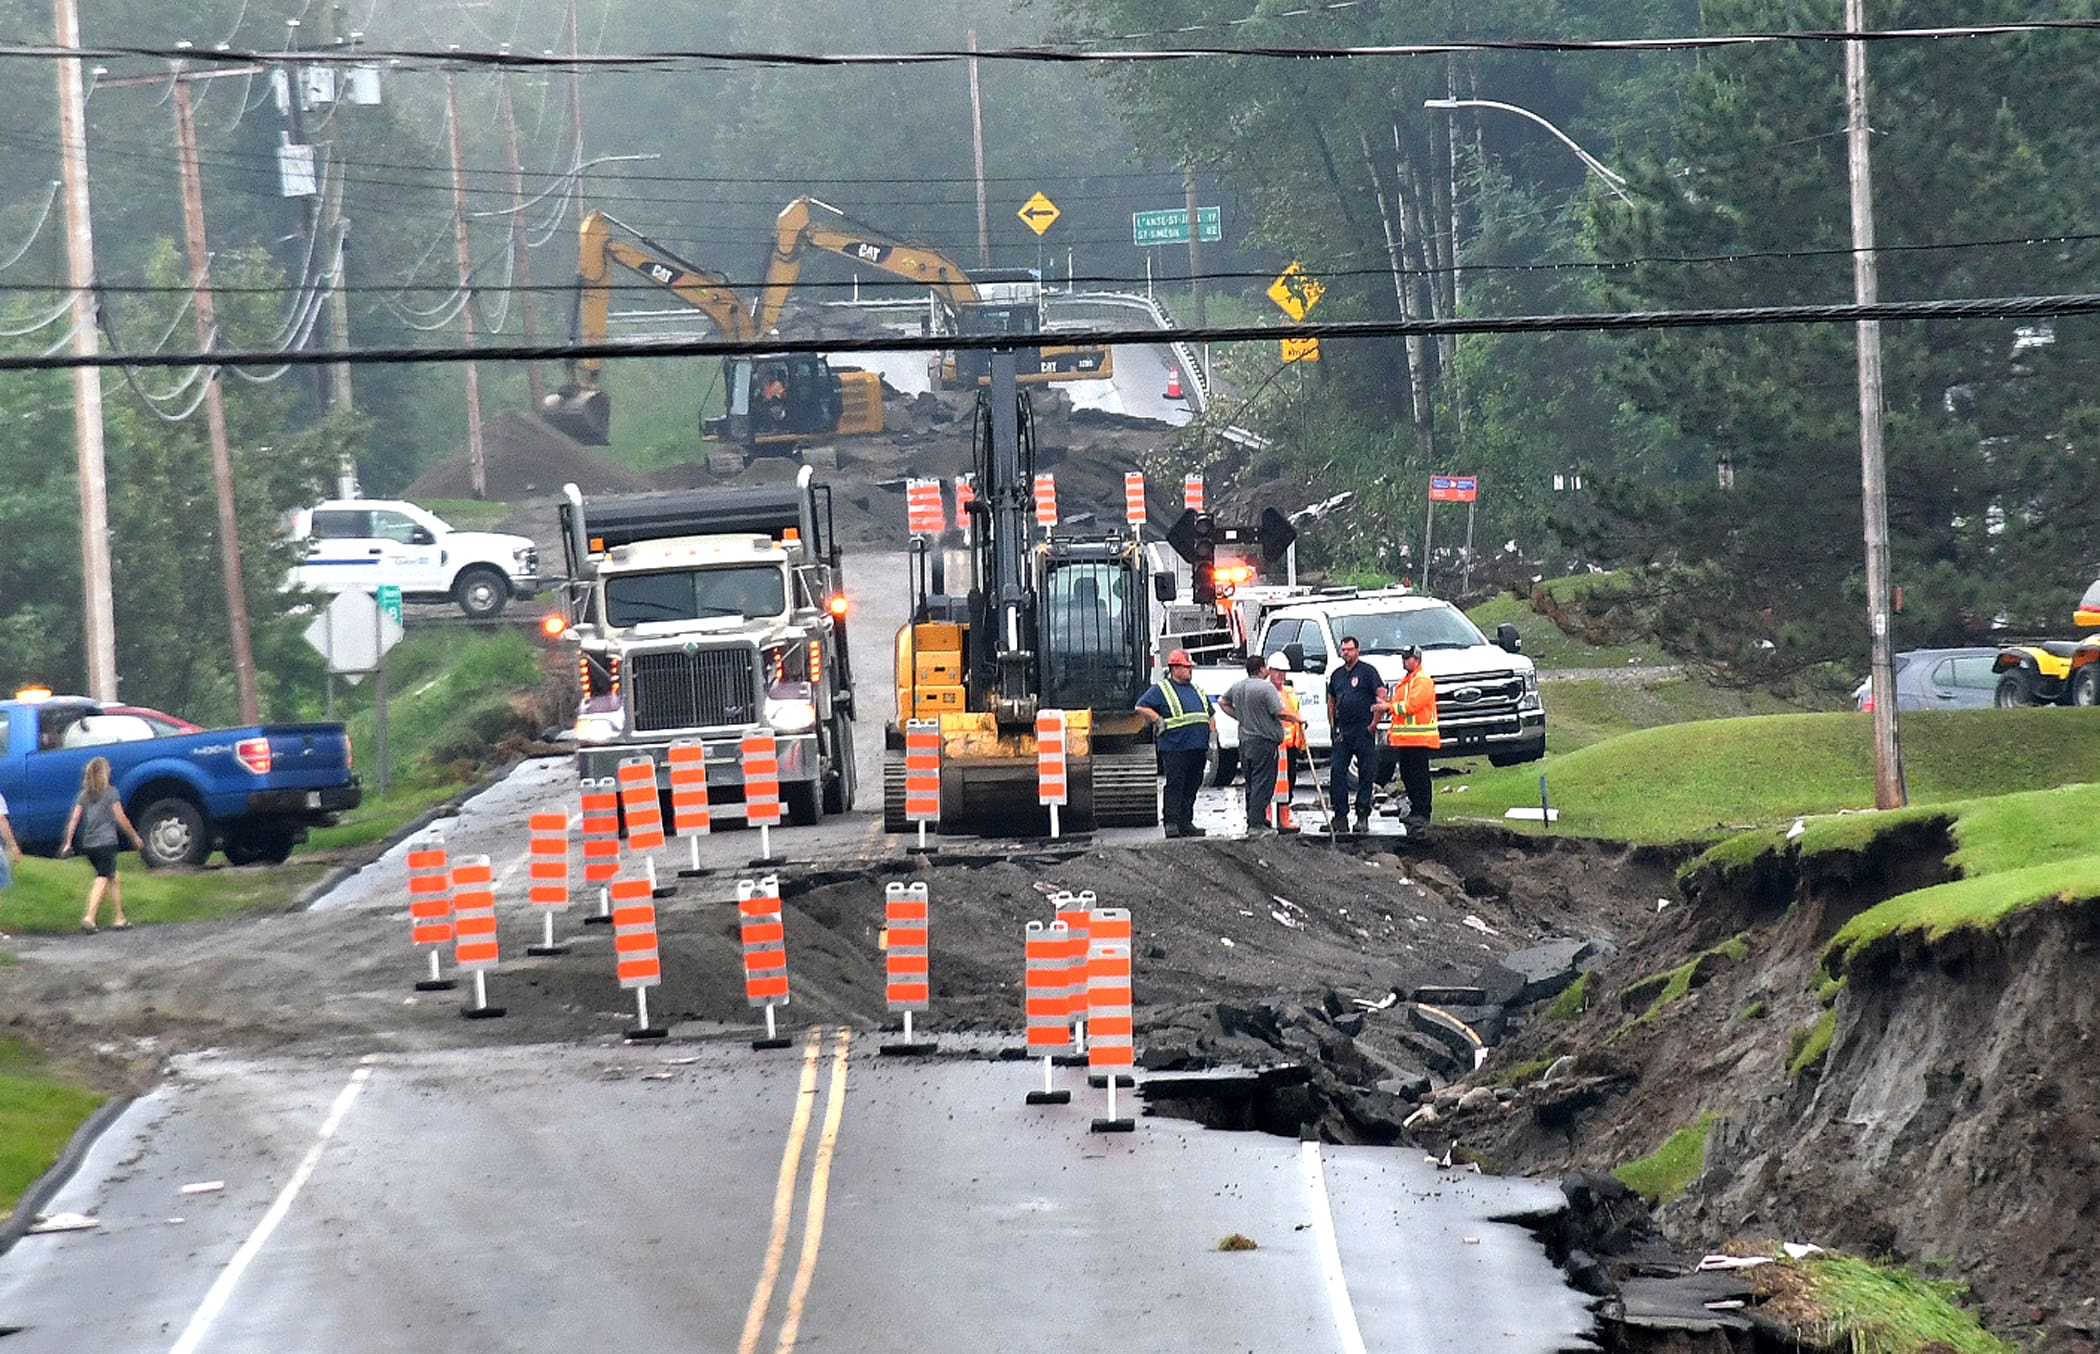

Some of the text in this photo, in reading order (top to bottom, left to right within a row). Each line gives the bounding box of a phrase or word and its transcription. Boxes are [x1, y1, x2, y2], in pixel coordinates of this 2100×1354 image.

[1136, 213, 1201, 227] L'ANSE-ST-J
[858, 243, 880, 261] CAT
[652, 264, 673, 283] CAT
